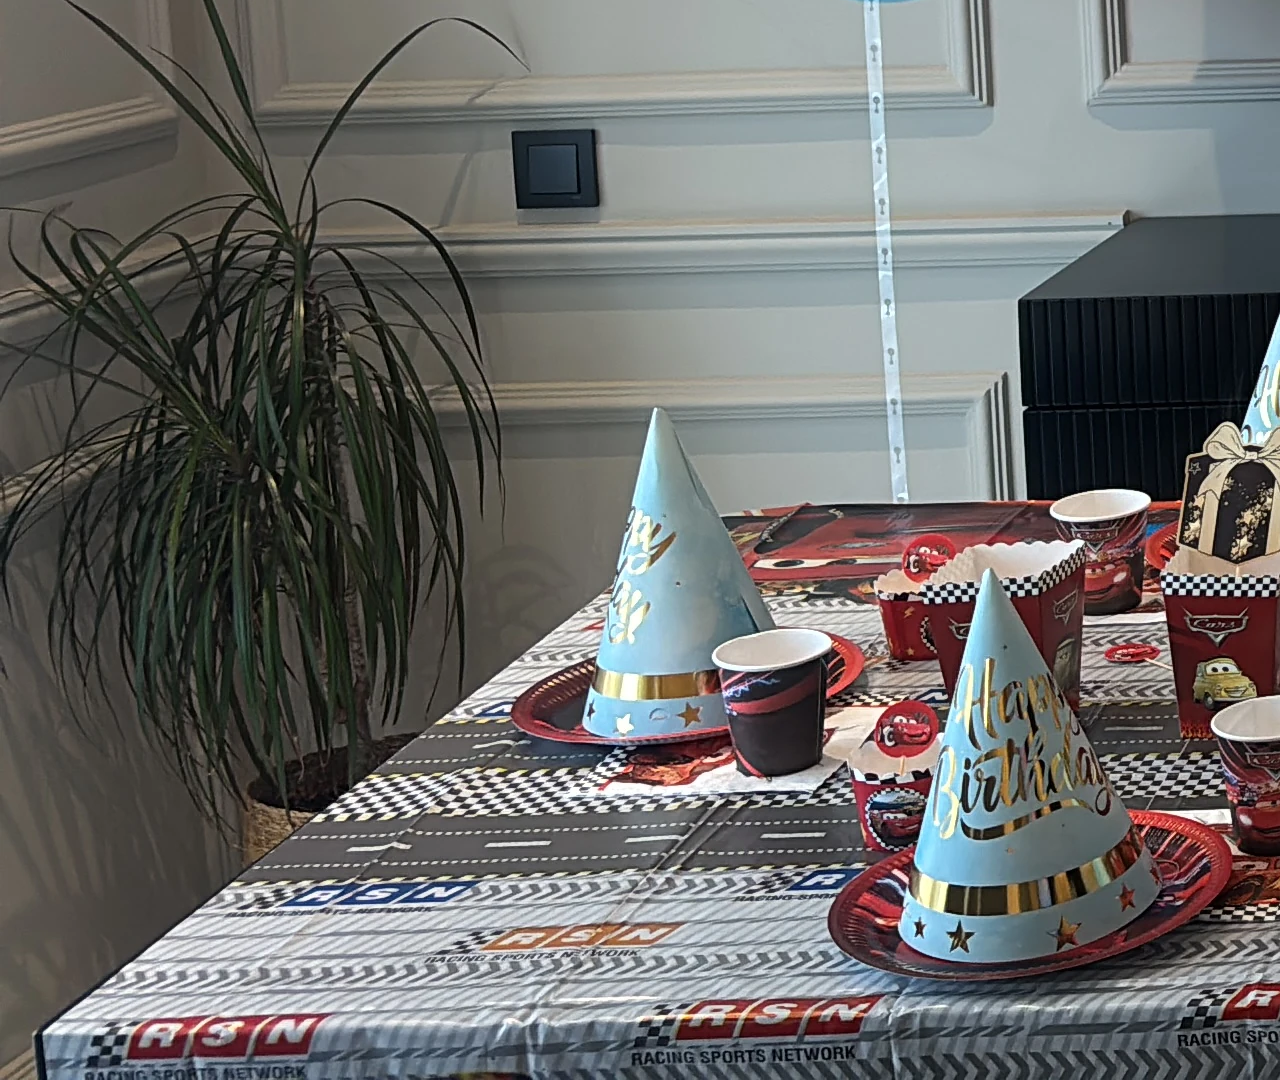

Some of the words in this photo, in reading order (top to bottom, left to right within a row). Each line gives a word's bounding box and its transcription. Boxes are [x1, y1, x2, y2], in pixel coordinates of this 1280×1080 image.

[689, 1003, 871, 1027] RSN
[138, 1018, 319, 1048] RSN
[1177, 1030, 1241, 1047] RACING
[631, 1050, 694, 1066] RACING
[700, 1049, 766, 1064] SPORTS
[772, 1045, 857, 1062] NETWORK
